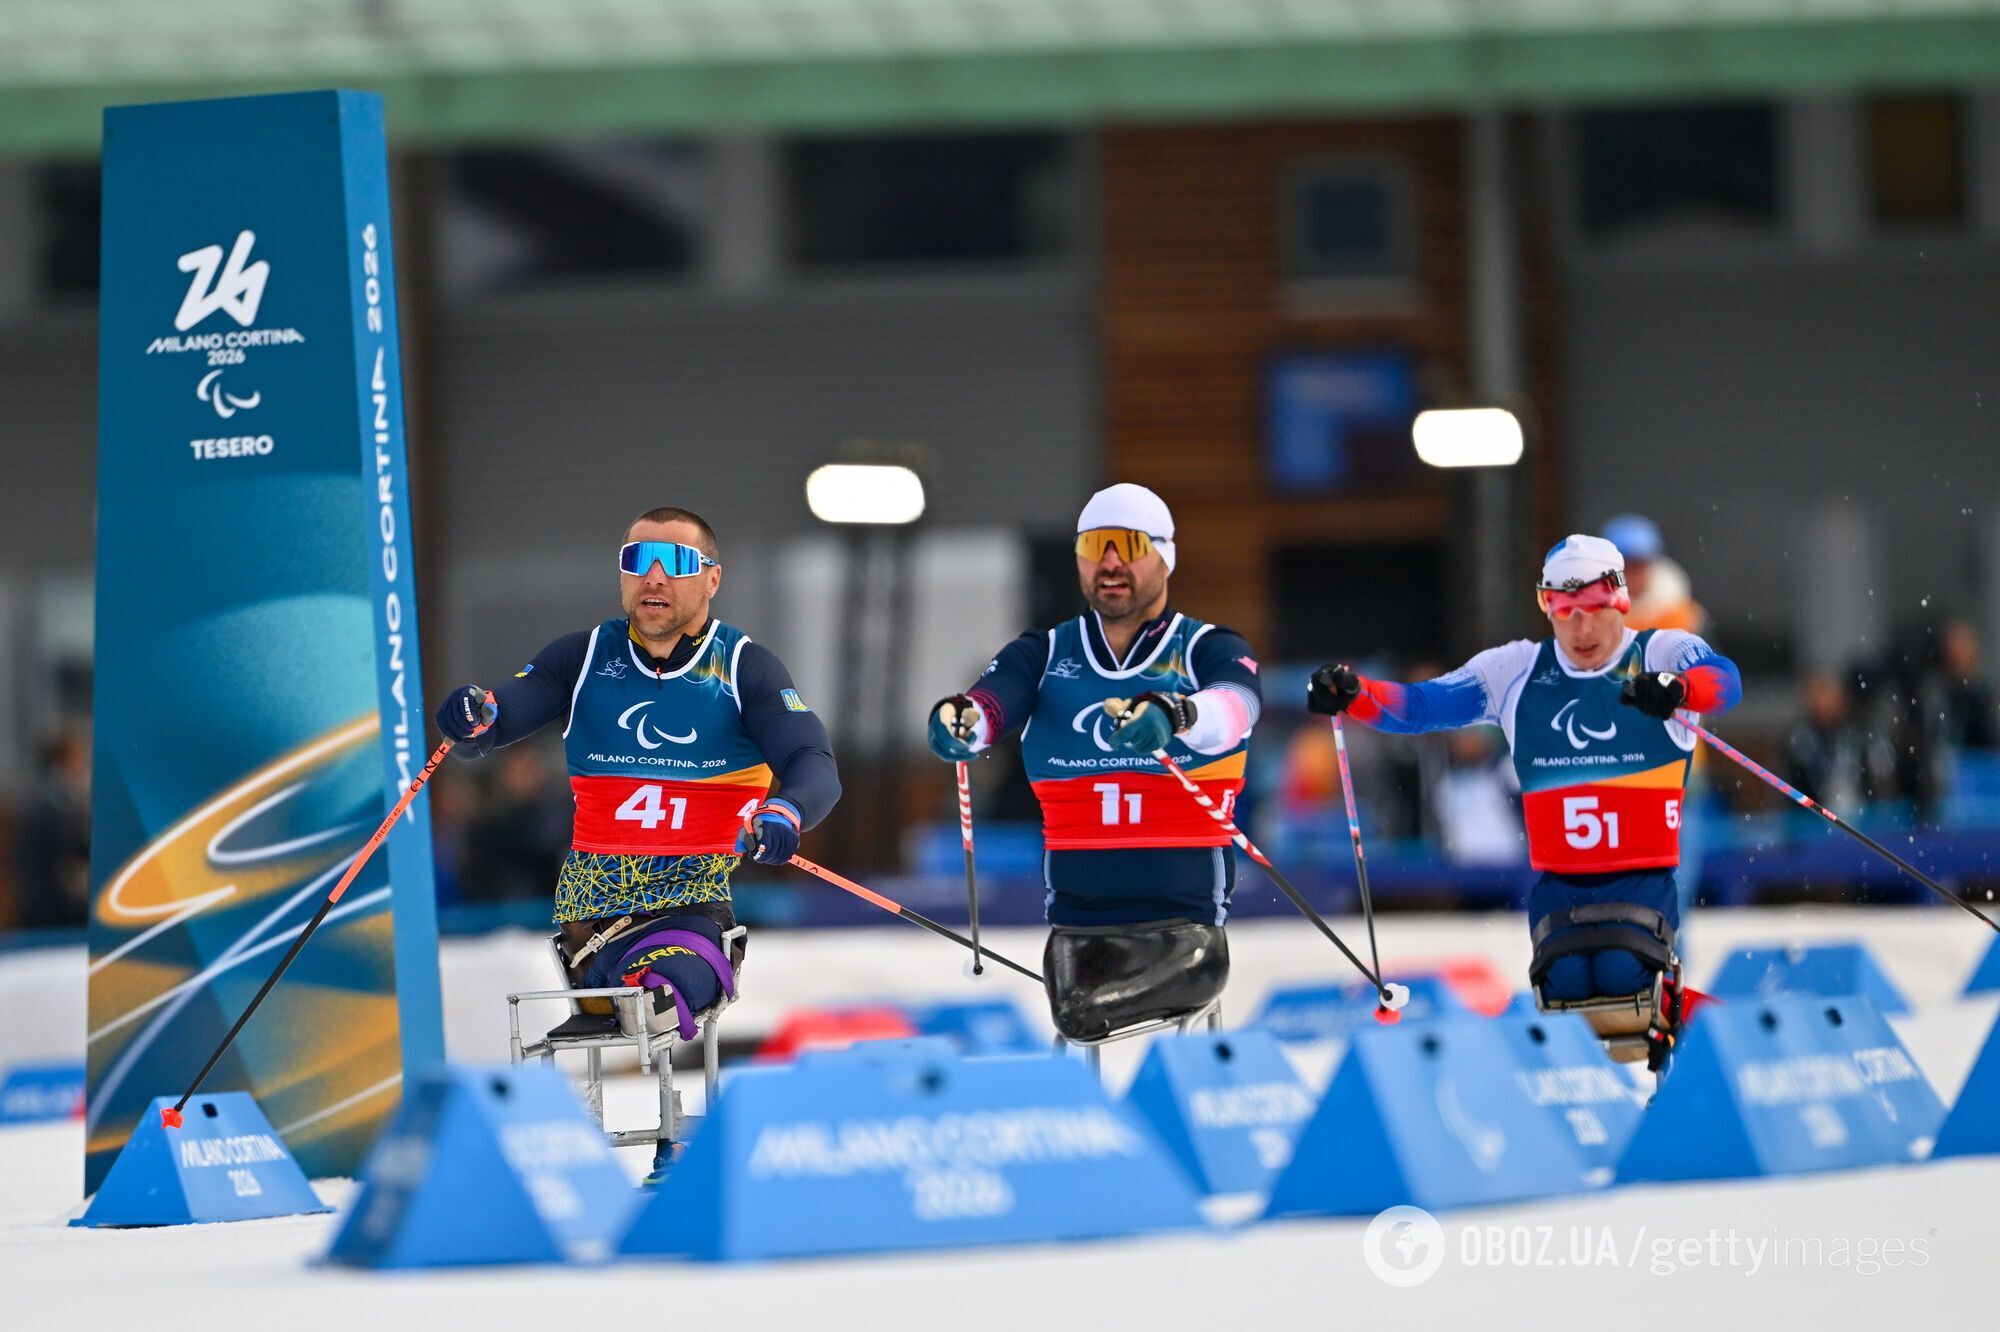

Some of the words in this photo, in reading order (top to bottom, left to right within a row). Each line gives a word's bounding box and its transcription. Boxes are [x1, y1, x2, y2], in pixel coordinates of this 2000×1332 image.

[361, 222, 383, 334] 2026
[145, 333, 224, 355] MILANO
[224, 327, 306, 349] CORTINA
[207, 348, 246, 367] 2026
[190, 433, 275, 461] TESERO
[371, 345, 400, 583] CORTINA
[388, 591, 416, 826] MILANO
[586, 752, 637, 765] MILANO
[637, 756, 699, 769] CORTINA
[701, 758, 727, 769] 2026
[1047, 756, 1097, 768] MILANO
[1099, 756, 1161, 768] CORTINA
[1171, 753, 1193, 766] 026
[1531, 756, 1571, 768] MILANO
[1571, 753, 1618, 767] CORTINA
[1621, 752, 1645, 763] 2026
[614, 783, 688, 830] 41
[1093, 782, 1142, 826] 11
[373, 816, 395, 842] PREMIO
[392, 806, 402, 817] 40
[1563, 796, 1619, 850] 51
